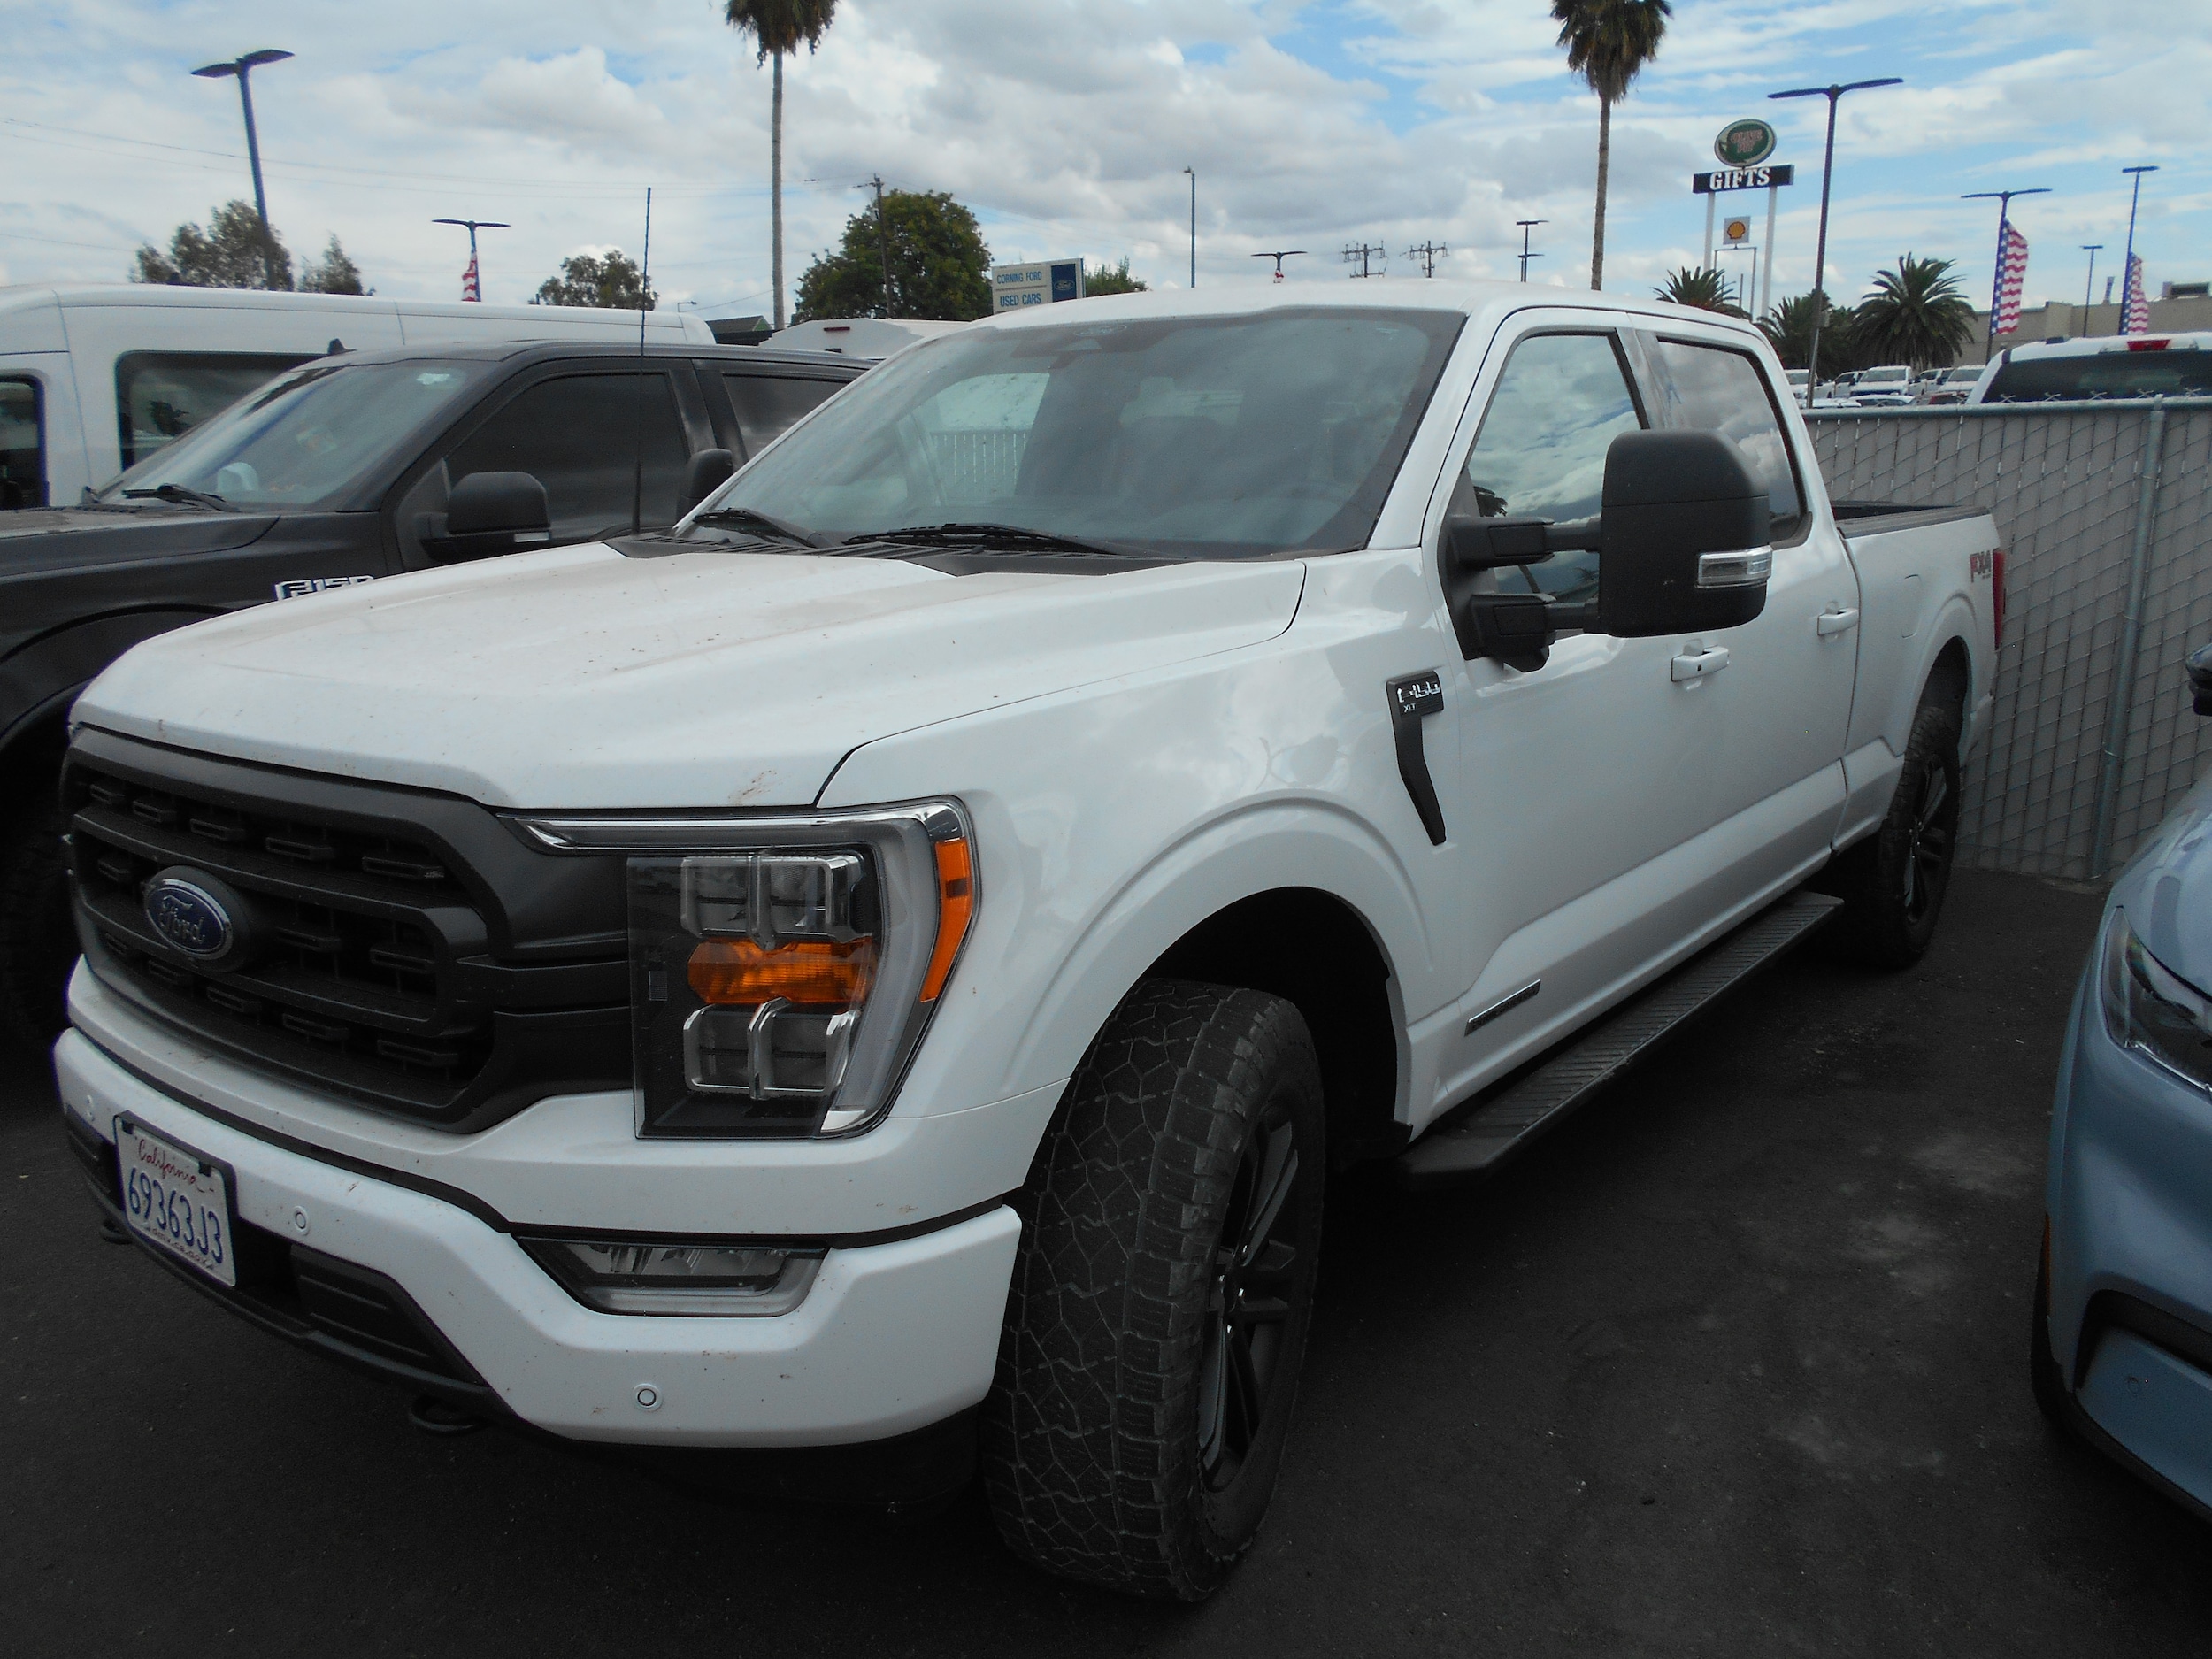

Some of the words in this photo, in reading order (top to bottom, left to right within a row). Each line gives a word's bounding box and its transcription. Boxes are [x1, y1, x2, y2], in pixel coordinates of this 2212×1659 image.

[1709, 167, 1770, 190] GIFTS
[996, 272, 1024, 284] CORNING
[1026, 271, 1042, 280] FORD
[1000, 295, 1019, 307] USED
[1022, 293, 1041, 304] CARS
[160, 895, 206, 944] Ford
[138, 1138, 205, 1193] California
[128, 1167, 223, 1264] 69363J3
